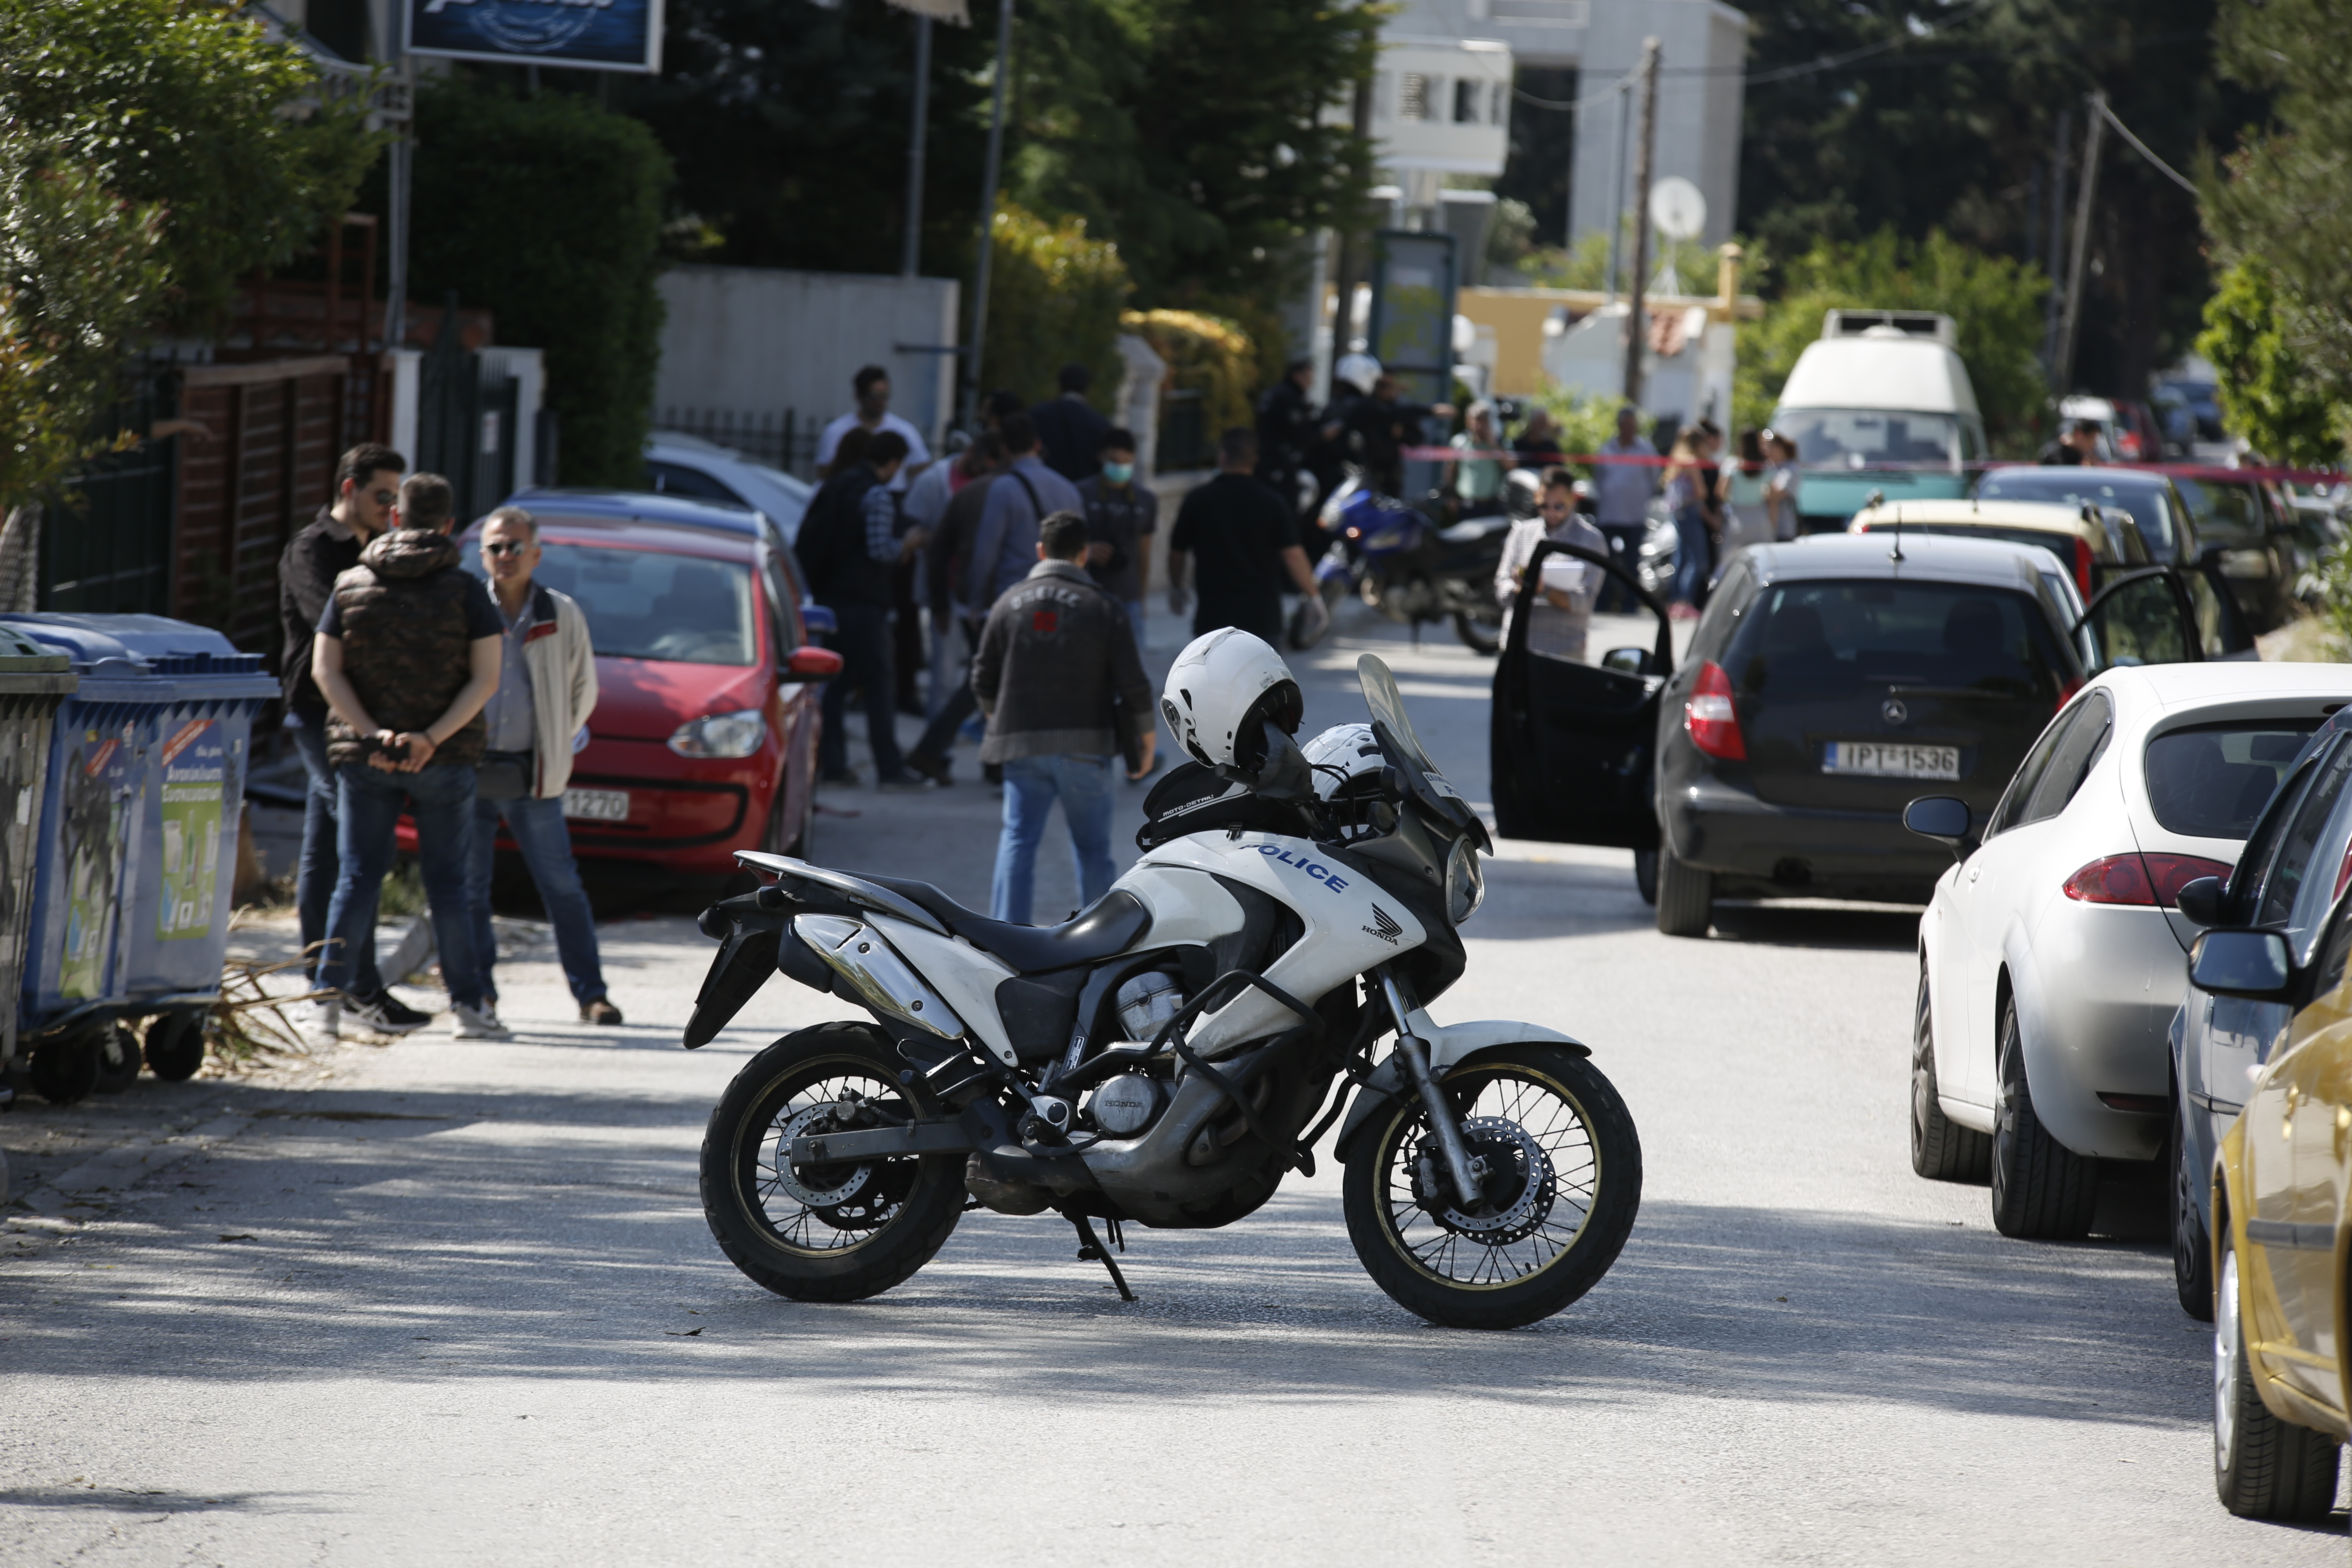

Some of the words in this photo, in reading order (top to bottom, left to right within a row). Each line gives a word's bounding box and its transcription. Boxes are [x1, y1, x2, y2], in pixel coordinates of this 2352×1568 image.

[570, 793, 626, 817] 1270
[1237, 844, 1350, 894] POLICE
[1361, 924, 1399, 946] HONDA
